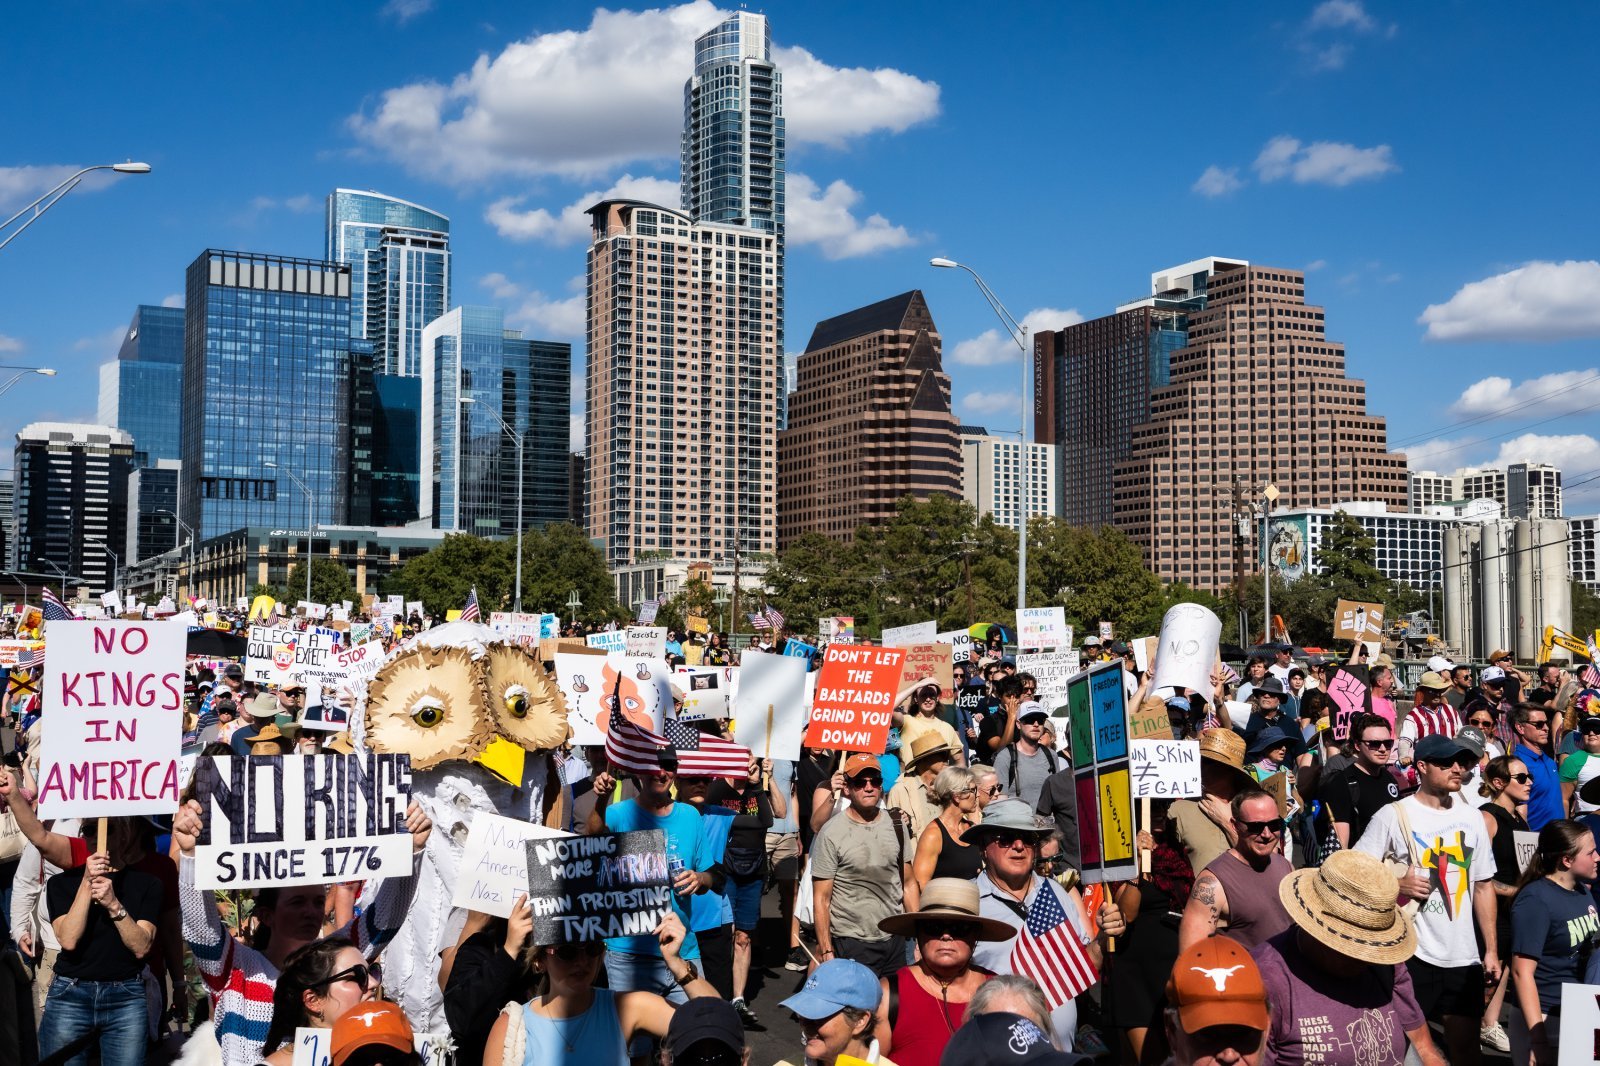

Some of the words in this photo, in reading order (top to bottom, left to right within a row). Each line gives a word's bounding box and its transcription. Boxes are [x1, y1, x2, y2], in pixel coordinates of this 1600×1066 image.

[1023, 609, 1053, 618] CARING
[94, 626, 149, 655] NO
[252, 627, 304, 646] ELECT
[309, 633, 319, 647] A
[590, 633, 622, 646] PUBLIC
[626, 627, 660, 639] Fascists
[953, 634, 969, 646] NO
[912, 645, 936, 654] OUR
[1564, 640, 1585, 652] KOMATSU
[338, 646, 367, 668] STOP
[828, 649, 872, 664] DON'T
[875, 651, 901, 666] LET
[904, 653, 949, 663] OCIETY
[1040, 653, 1054, 661] AND
[255, 670, 271, 680] THE
[319, 677, 338, 685] JOKE
[847, 669, 874, 684] THE
[62, 671, 181, 710] KINGS
[1093, 677, 1119, 693] FREEDOM
[819, 687, 891, 706] BASTARDS
[812, 707, 855, 724] GRIND
[861, 710, 891, 727] YOU
[84, 718, 137, 742] IN
[821, 728, 872, 747] DOWN!
[1098, 724, 1121, 748] FREE
[38, 759, 179, 804] AMERICA
[194, 754, 284, 846] NO
[303, 752, 413, 841] KINGS
[1105, 784, 1131, 854] RESIST
[534, 836, 617, 866] NOTHING
[216, 848, 306, 883] SINCE
[321, 845, 382, 878] 1776
[474, 851, 527, 880] Americ
[595, 853, 670, 887] AMERICAN
[470, 879, 504, 903] Nazi
[530, 894, 572, 917] THAN
[577, 886, 671, 911] PROTESTING
[1298, 1015, 1330, 1027] THESE
[1300, 1024, 1334, 1036] BOOTS
[1301, 1035, 1323, 1043] ARE
[1302, 1043, 1334, 1052] MADE
[1303, 1052, 1325, 1062] FOR
